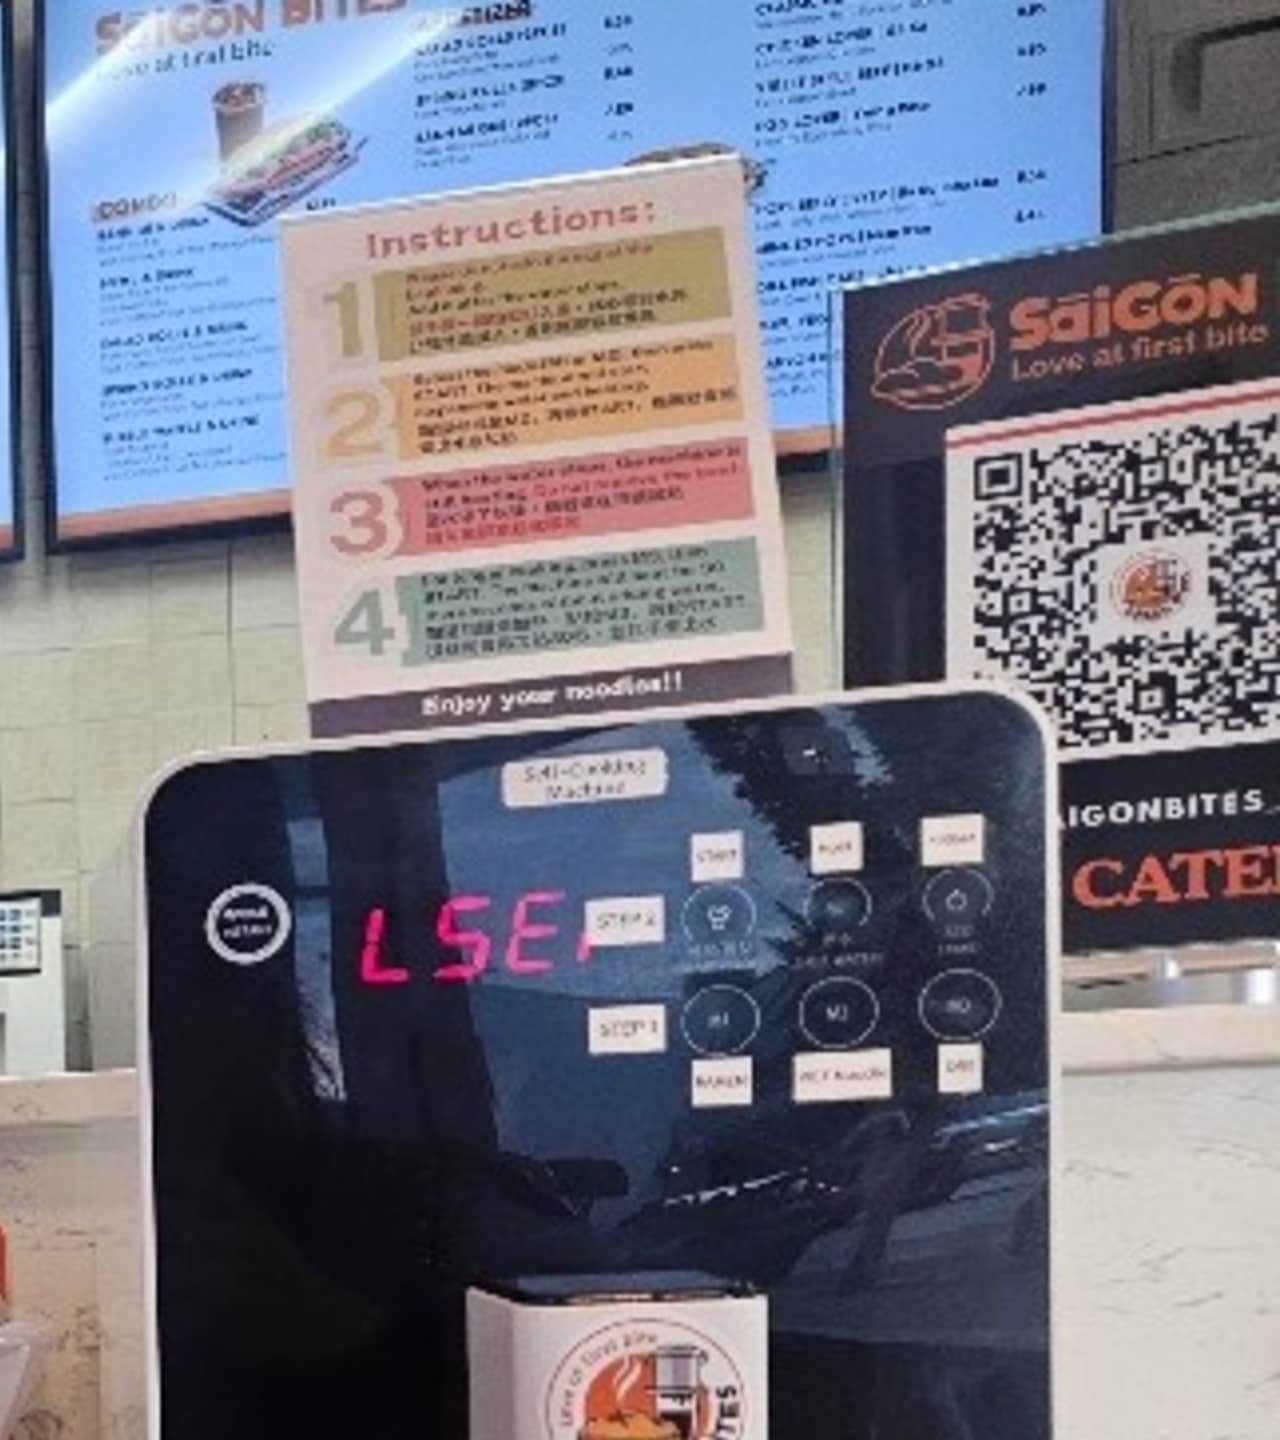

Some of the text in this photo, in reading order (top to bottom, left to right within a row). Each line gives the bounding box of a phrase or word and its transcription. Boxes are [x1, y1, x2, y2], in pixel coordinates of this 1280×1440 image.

[367, 200, 656, 258] Instructions:
[321, 283, 361, 357] 1
[1011, 322, 1268, 381] Love at first bite
[323, 394, 384, 456] 2
[329, 490, 394, 553] 3
[334, 589, 395, 656] 4
[421, 671, 684, 716] Enjoy your noodles!!
[1071, 845, 1280, 908] CATE
[360, 888, 594, 983] LSE
